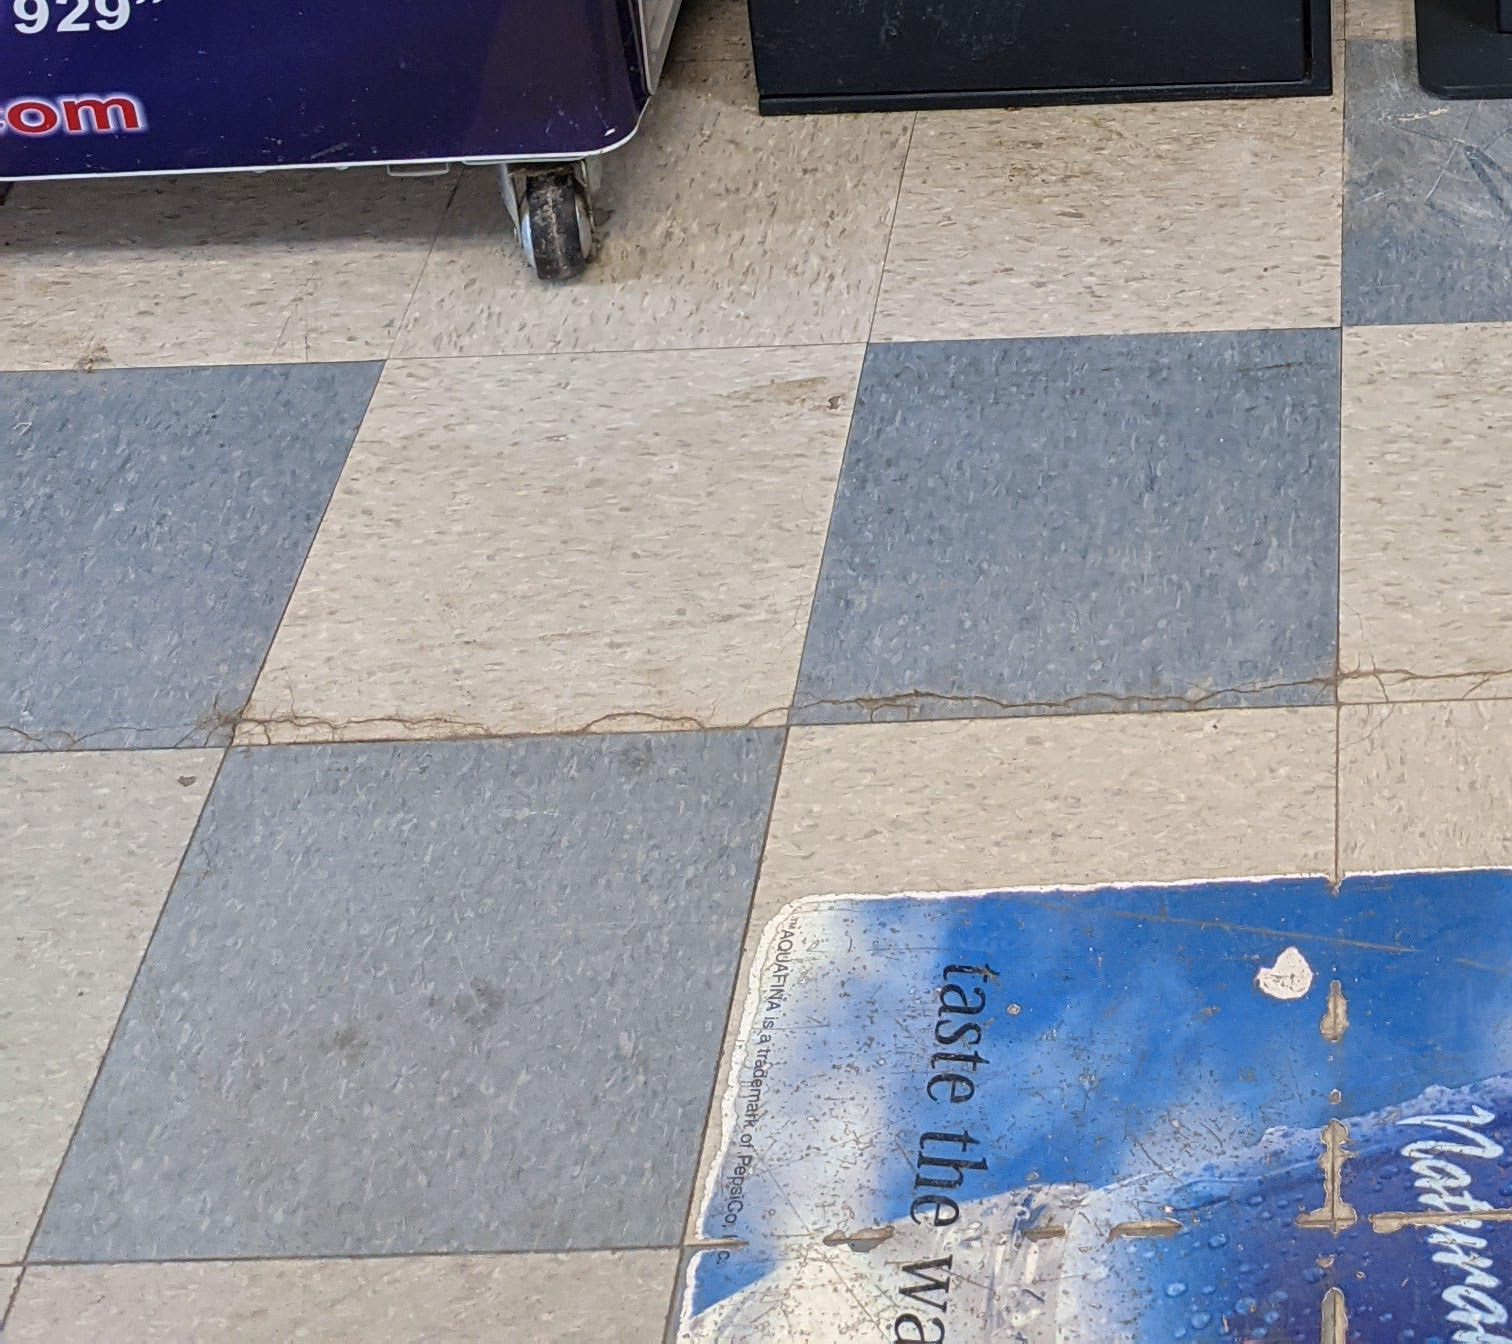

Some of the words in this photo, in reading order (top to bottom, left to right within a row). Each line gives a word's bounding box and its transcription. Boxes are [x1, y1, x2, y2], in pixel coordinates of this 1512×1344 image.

[765, 929, 794, 1011] AQUAFINA
[759, 1034, 772, 1044] a
[763, 1017, 779, 1028] is
[927, 962, 1001, 1104] taste
[743, 1047, 772, 1128] trademark
[740, 1134, 752, 1148] of
[909, 1129, 989, 1226] the
